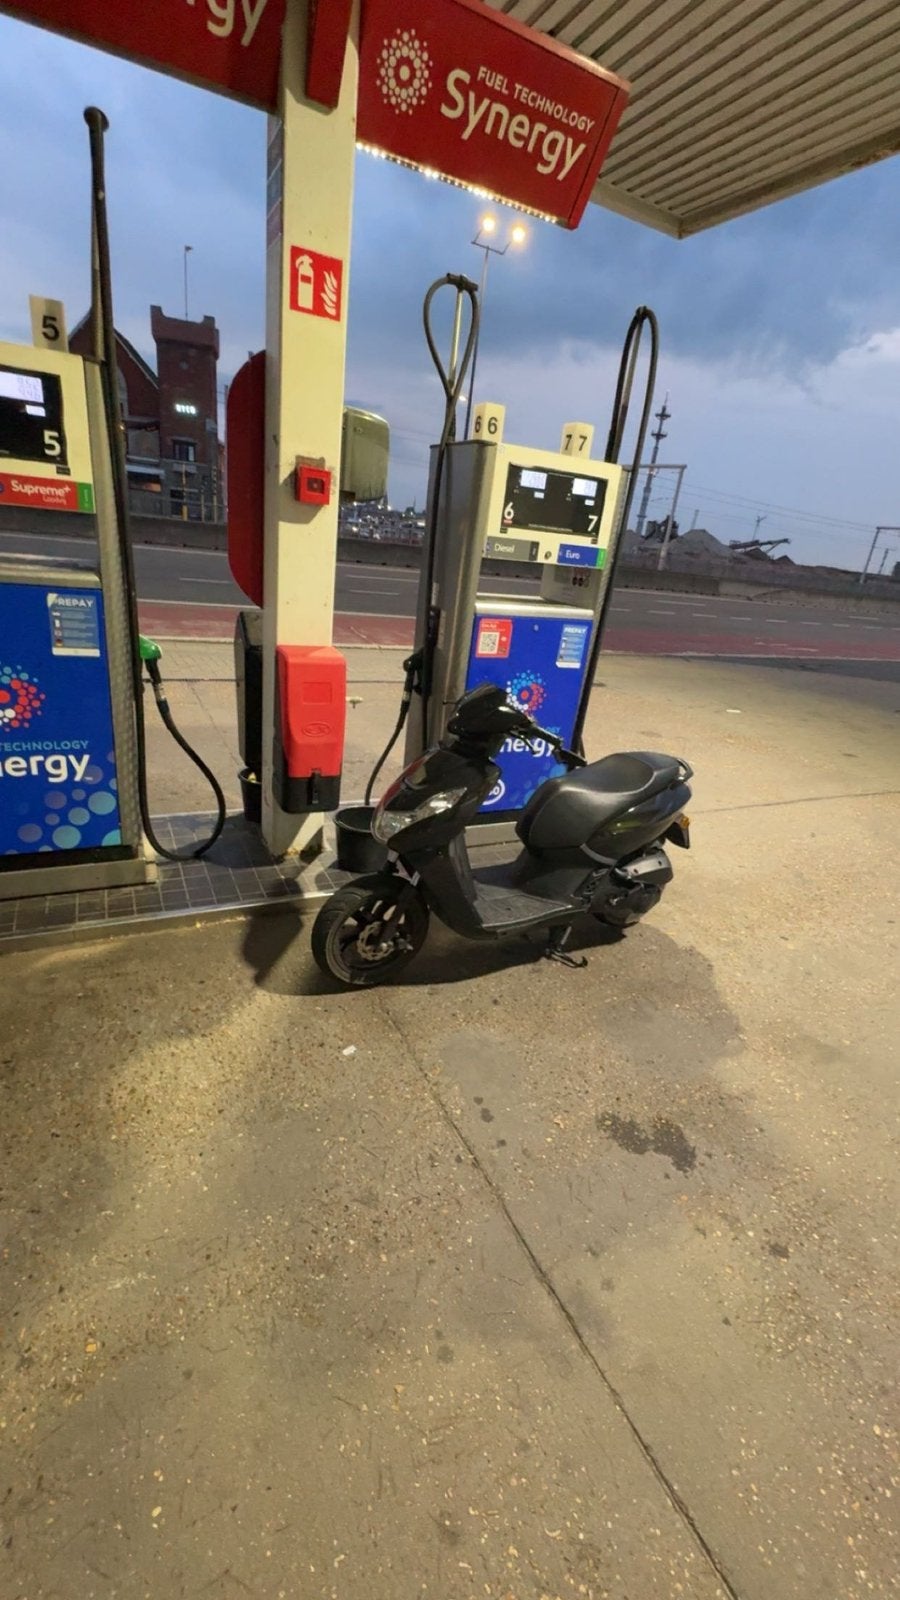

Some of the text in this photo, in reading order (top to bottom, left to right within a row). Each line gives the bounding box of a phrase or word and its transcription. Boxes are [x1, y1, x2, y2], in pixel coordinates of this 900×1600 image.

[186, 0, 268, 47] gy
[477, 66, 595, 133] FUEL TECHNOLOGY
[440, 68, 587, 181] Synergy
[41, 315, 60, 342] 5
[474, 415, 483, 434] 6
[487, 416, 498, 435] 6
[43, 429, 61, 457] 5
[563, 434, 573, 451] 7
[578, 435, 588, 452] 7
[10, 480, 71, 497] Supreme+
[503, 502, 515, 520] 6
[587, 515, 599, 532] 7
[494, 543, 516, 553] Diesel
[565, 549, 581, 559] Euro
[56, 597, 95, 608] REPAY
[0, 754, 91, 784] ergy
